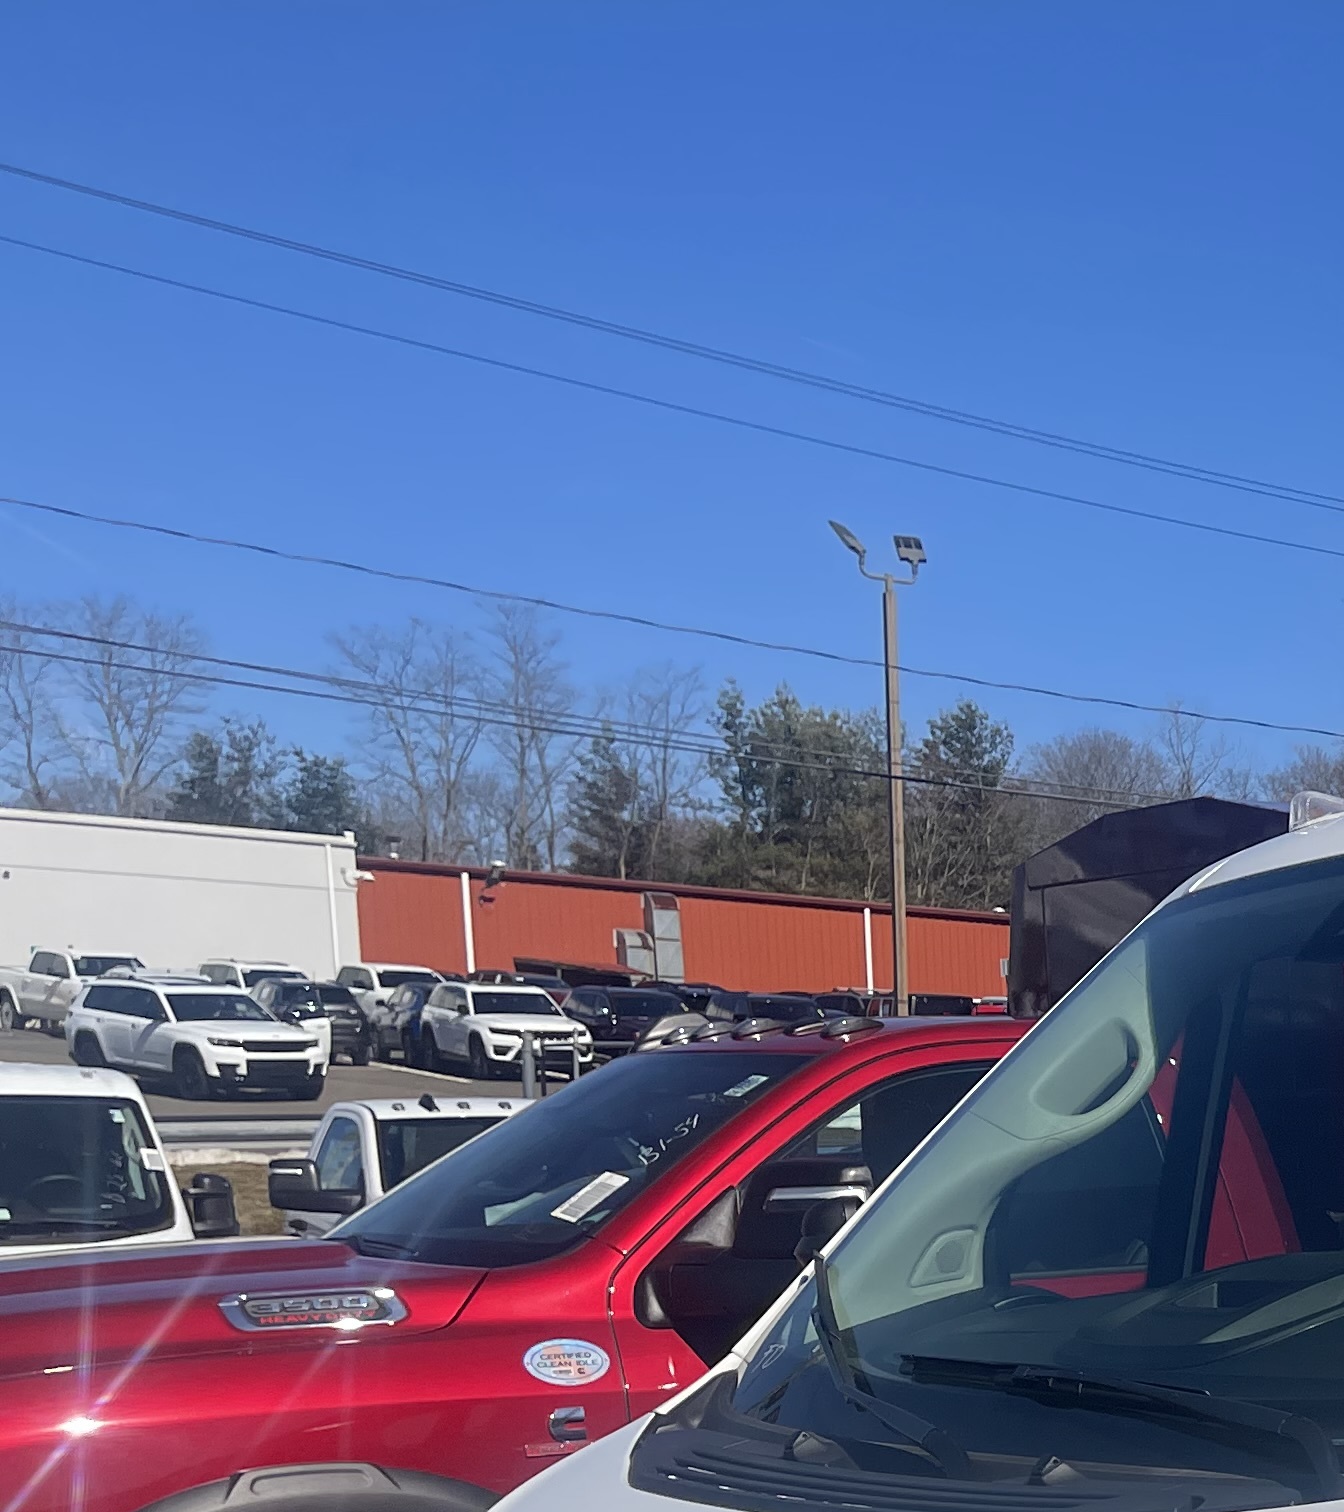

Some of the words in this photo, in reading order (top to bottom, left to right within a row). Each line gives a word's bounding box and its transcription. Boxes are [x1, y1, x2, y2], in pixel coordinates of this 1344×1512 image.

[251, 1295, 369, 1314] 3500
[260, 1312, 321, 1325] HEAVY
[540, 1351, 592, 1361] CERTIFIED
[536, 1360, 573, 1369] CLEAN
